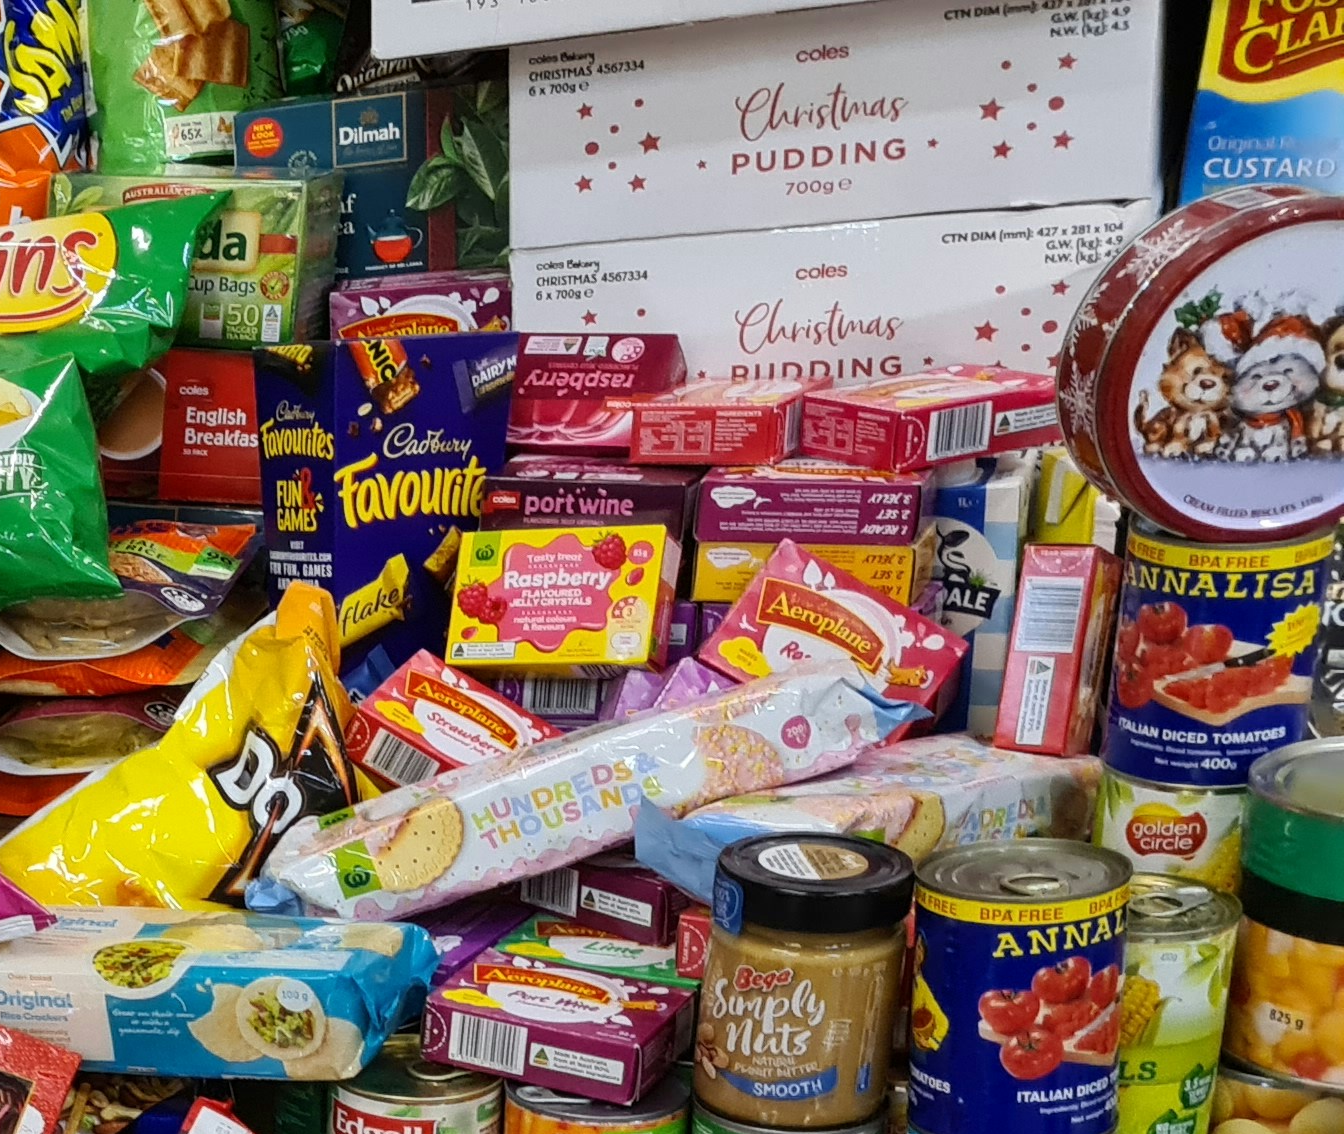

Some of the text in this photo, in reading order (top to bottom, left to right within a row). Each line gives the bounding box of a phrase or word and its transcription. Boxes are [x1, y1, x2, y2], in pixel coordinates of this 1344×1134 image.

[795, 43, 850, 62] coles
[734, 82, 909, 141] Christmas
[339, 123, 400, 146] Dilmah
[732, 138, 908, 175] PUDDING
[1203, 156, 1335, 179] CUSTARD
[785, 178, 834, 197] 700g
[942, 232, 968, 244] CTN
[971, 231, 996, 242] DIM
[999, 228, 1034, 242] (mm):
[1037, 227, 1058, 237] 427
[1103, 222, 1124, 232] 104
[536, 257, 600, 272] coles Bakery
[795, 261, 847, 281] coles
[536, 268, 648, 286] CHRISTMAS 4567334
[555, 288, 581, 304] 700g
[227, 302, 260, 325] 50
[734, 298, 904, 355] Christmas
[525, 367, 633, 388] raspberry
[185, 406, 247, 425] English
[184, 427, 258, 448] Breakfas
[260, 418, 335, 460] Favourites
[383, 422, 472, 460] Cadbury
[524, 494, 634, 516] port wine
[277, 510, 317, 532] GAMES
[1189, 555, 1270, 569] BPA FREE
[504, 569, 611, 593] Raspberry
[1125, 562, 1315, 598] ANNALISA
[413, 680, 507, 737] Aeroplane
[1118, 718, 1287, 745] ITALIAN DICED TOMATOES
[472, 760, 633, 832] HUNDREDS
[480, 776, 663, 850] THOUSANDS
[1132, 818, 1201, 840] golden
[1139, 835, 1193, 850] circle
[980, 906, 1064, 922] BPA FREE
[733, 965, 794, 991] Bega
[712, 978, 826, 1034] Simply
[1269, 1008, 1292, 1025] 825
[752, 1079, 822, 1097] SMOOTH
